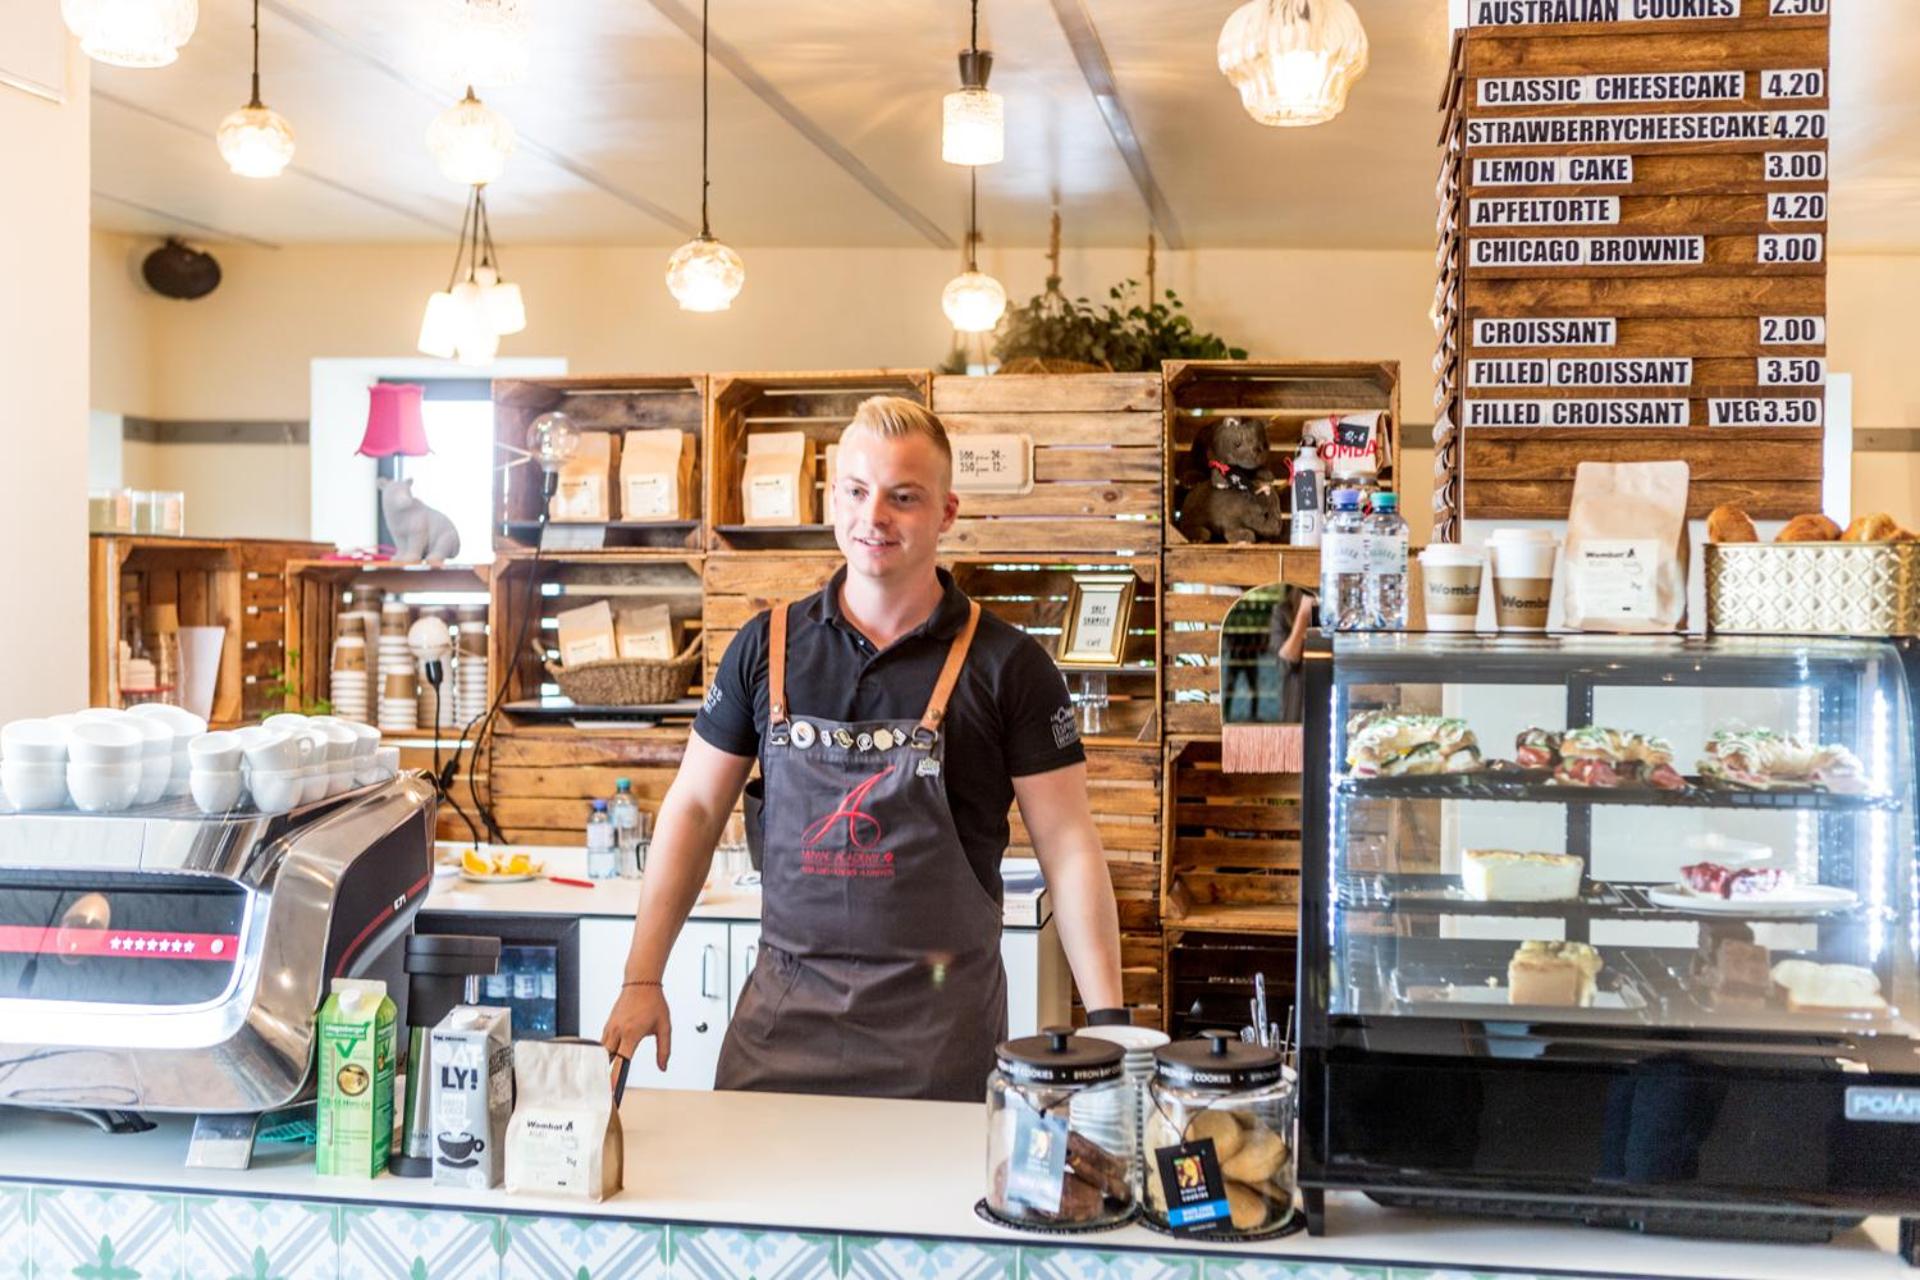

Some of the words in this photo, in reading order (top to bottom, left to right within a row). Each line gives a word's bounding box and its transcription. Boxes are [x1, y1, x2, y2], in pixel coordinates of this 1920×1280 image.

[1478, 0, 1619, 24] AUSTRALIAN
[1633, 0, 1735, 20] COOKIES
[1484, 78, 1581, 102] CLASSIC
[1594, 74, 1741, 100] CHEESECAKE
[1768, 73, 1821, 97] 4.20
[1773, 114, 1826, 138] 4.20
[1480, 159, 1556, 182] LEMON
[1569, 158, 1628, 181] CAKE
[1768, 154, 1823, 178] 3.00
[1476, 199, 1611, 223] APFELTORTE
[1772, 195, 1825, 219] 4.20
[1476, 239, 1581, 263] CHICAGO
[1590, 238, 1700, 262] BROWNIE
[1763, 238, 1818, 261] 3.00
[1479, 321, 1612, 344] CROISSANT
[1763, 318, 1816, 342] 2.00
[1474, 361, 1545, 384] FILLED
[1556, 360, 1690, 385] CROISSANT
[1767, 359, 1821, 383] 3.50
[1471, 403, 1541, 425] FILLED
[1552, 401, 1686, 425] CROISSANT
[1715, 400, 1760, 424] VEG
[1763, 400, 1817, 424] 3.50
[441, 1065, 479, 1091] LY!
[1073, 1069, 1099, 1081] BYRON
[1194, 1072, 1232, 1084] COOKIES
